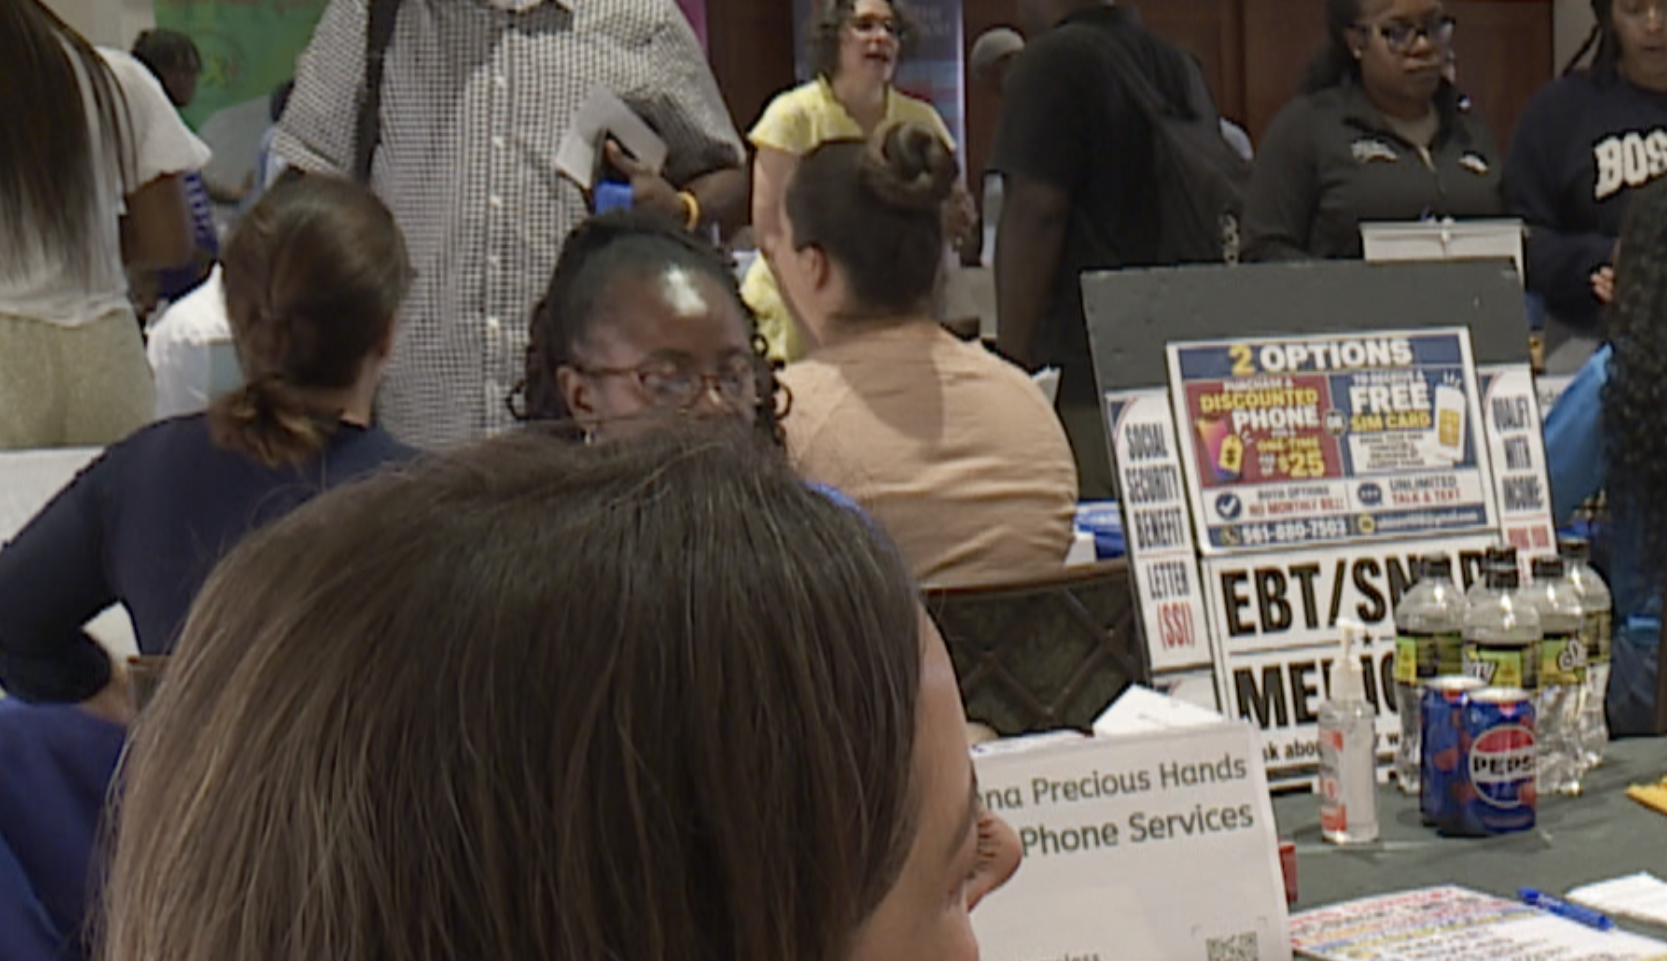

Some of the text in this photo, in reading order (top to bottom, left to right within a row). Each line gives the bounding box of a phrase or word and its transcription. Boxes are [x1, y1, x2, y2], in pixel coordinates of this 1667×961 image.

[1228, 337, 1413, 376] 2 OPTIONS
[1201, 387, 1318, 414] DISCOUNTED
[1348, 382, 1432, 414] FREE
[1231, 405, 1321, 436] PHONE
[1350, 410, 1431, 433] SIM CARD
[1124, 421, 1168, 462] SOCIAL
[1125, 463, 1181, 504] SECURITY
[1277, 450, 1325, 478] $25
[1389, 475, 1457, 492] UNLIMITED
[1133, 506, 1185, 550] BENEFIT
[1146, 560, 1190, 600] LETTER
[1156, 602, 1196, 650] (SSI)
[1030, 770, 1152, 806] Precious
[1159, 753, 1248, 790] Hands
[1020, 803, 1255, 858] Phone Services
